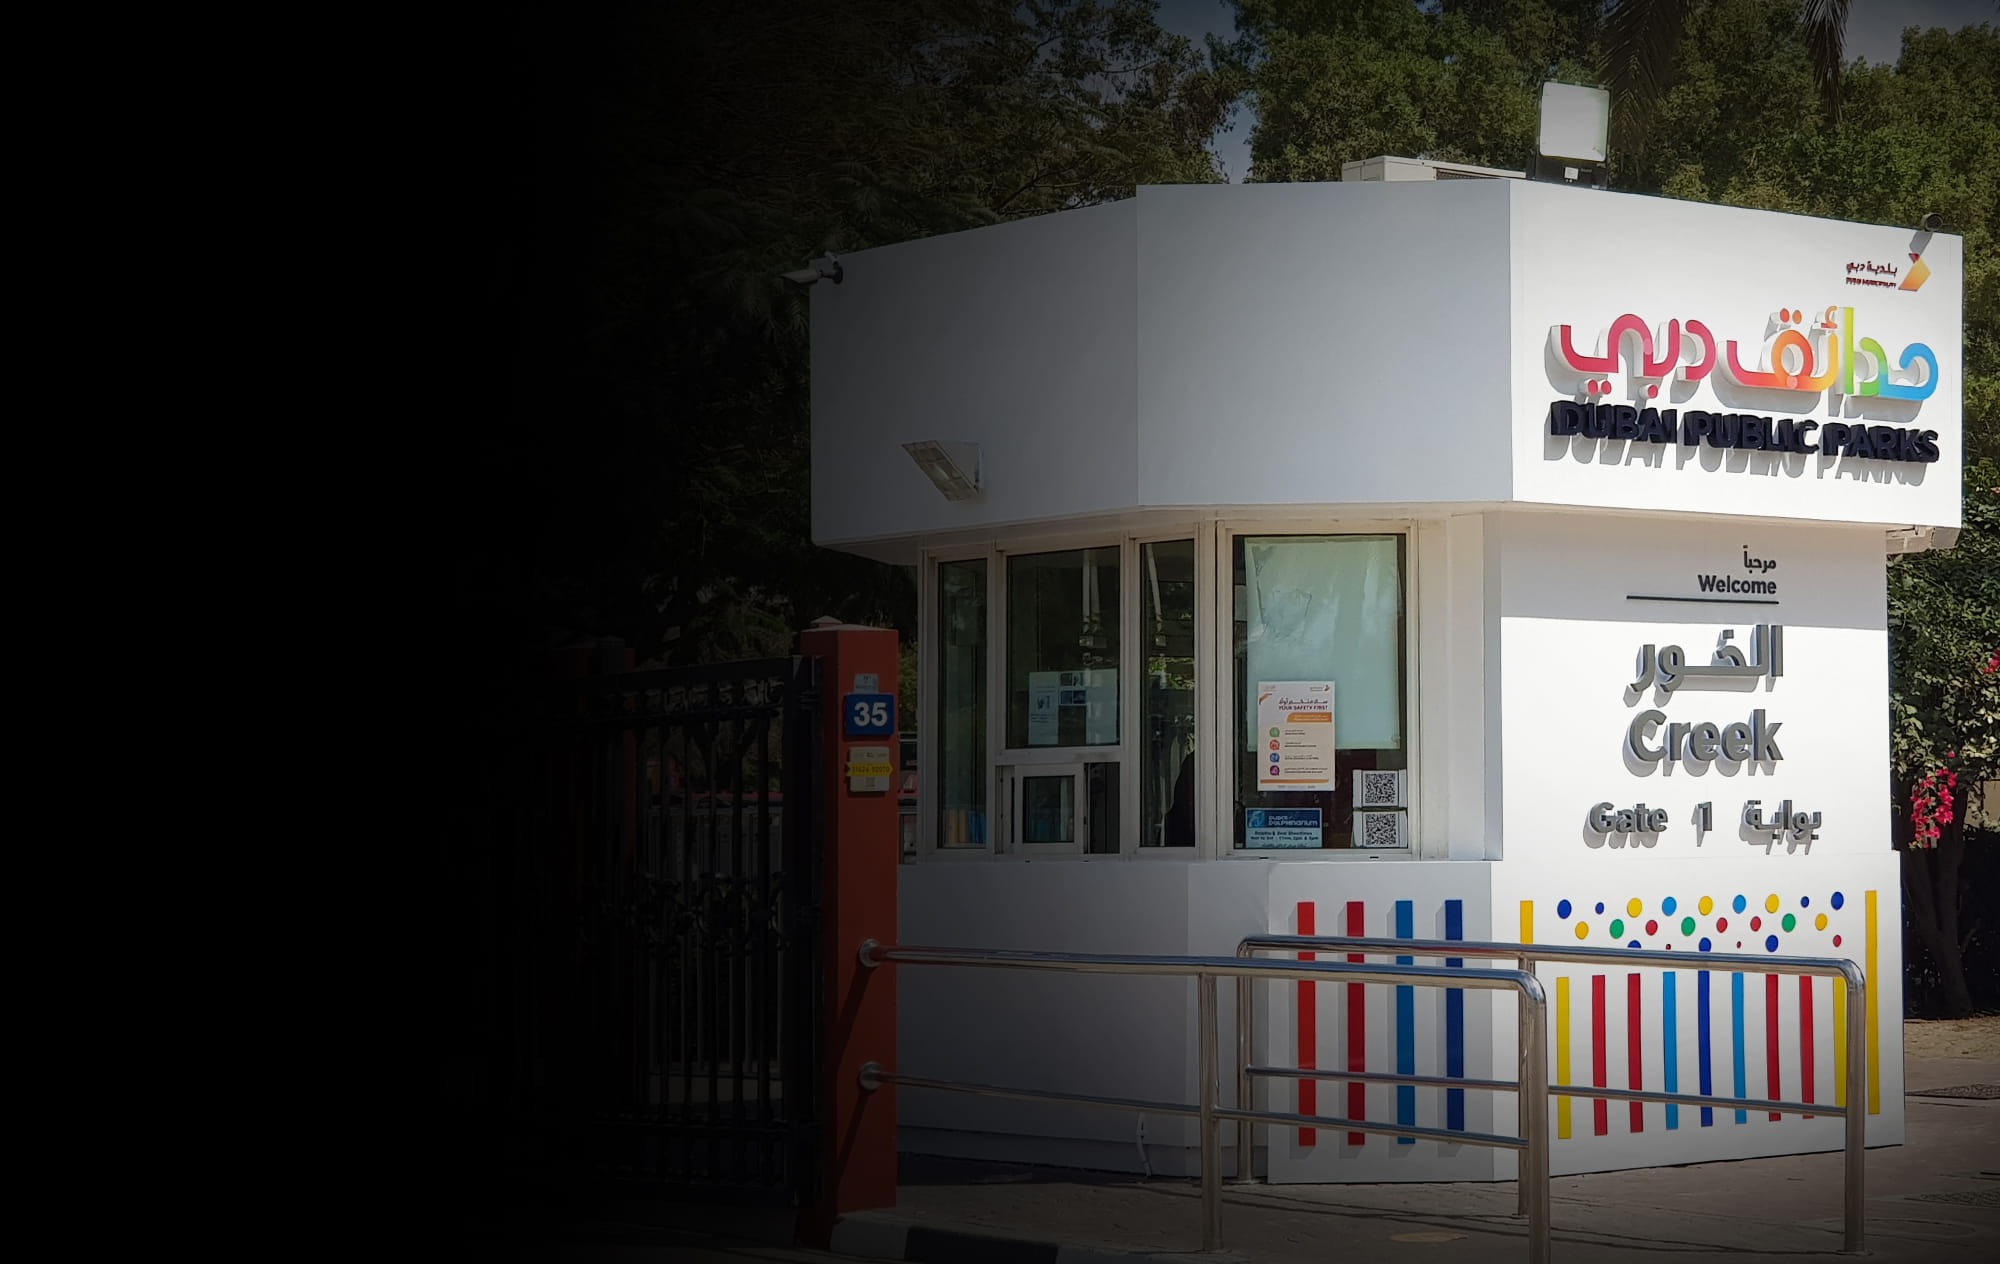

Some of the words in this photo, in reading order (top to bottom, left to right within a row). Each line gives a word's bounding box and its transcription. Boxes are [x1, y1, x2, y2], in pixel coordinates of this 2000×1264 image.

[1846, 262, 1865, 274] دبي
[1867, 261, 1897, 277] بلدية
[1553, 313, 1716, 399] دبي
[1551, 400, 1677, 443] DUBAI
[1683, 411, 1820, 454] PUBLIC
[1822, 422, 1939, 462] PARKS
[1697, 575, 1777, 594] Welcome
[1628, 624, 1783, 691] الخور
[854, 701, 888, 727] 35
[1628, 709, 1783, 762] Creek
[1589, 801, 1668, 833] Gate
[1697, 801, 1712, 831] 1
[1746, 799, 1822, 840] بوابة
